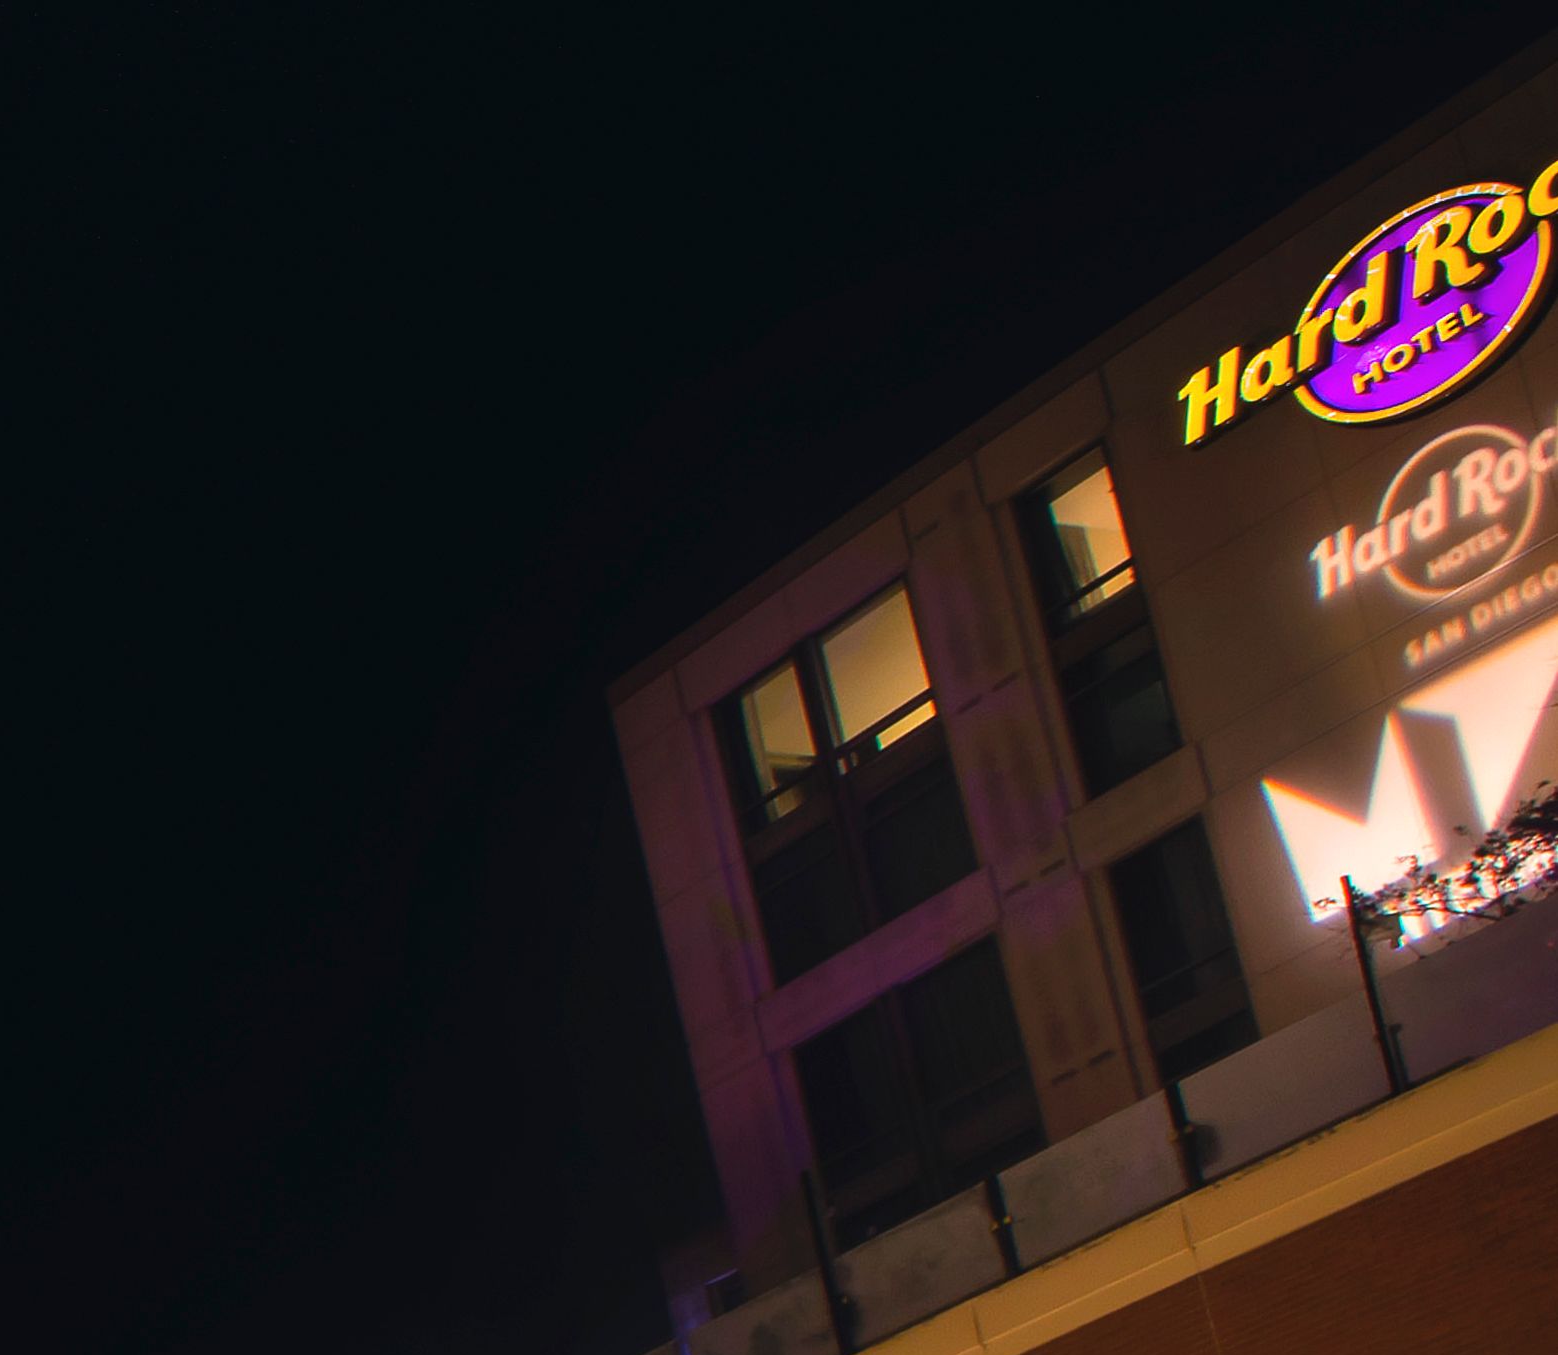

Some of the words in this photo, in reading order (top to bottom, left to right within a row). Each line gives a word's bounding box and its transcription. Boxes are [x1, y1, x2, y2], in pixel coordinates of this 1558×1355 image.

[1178, 250, 1388, 446] Hard
[1352, 303, 1484, 395] HOTEL
[1310, 470, 1448, 600] Hard
[1403, 615, 1467, 668] SAN
